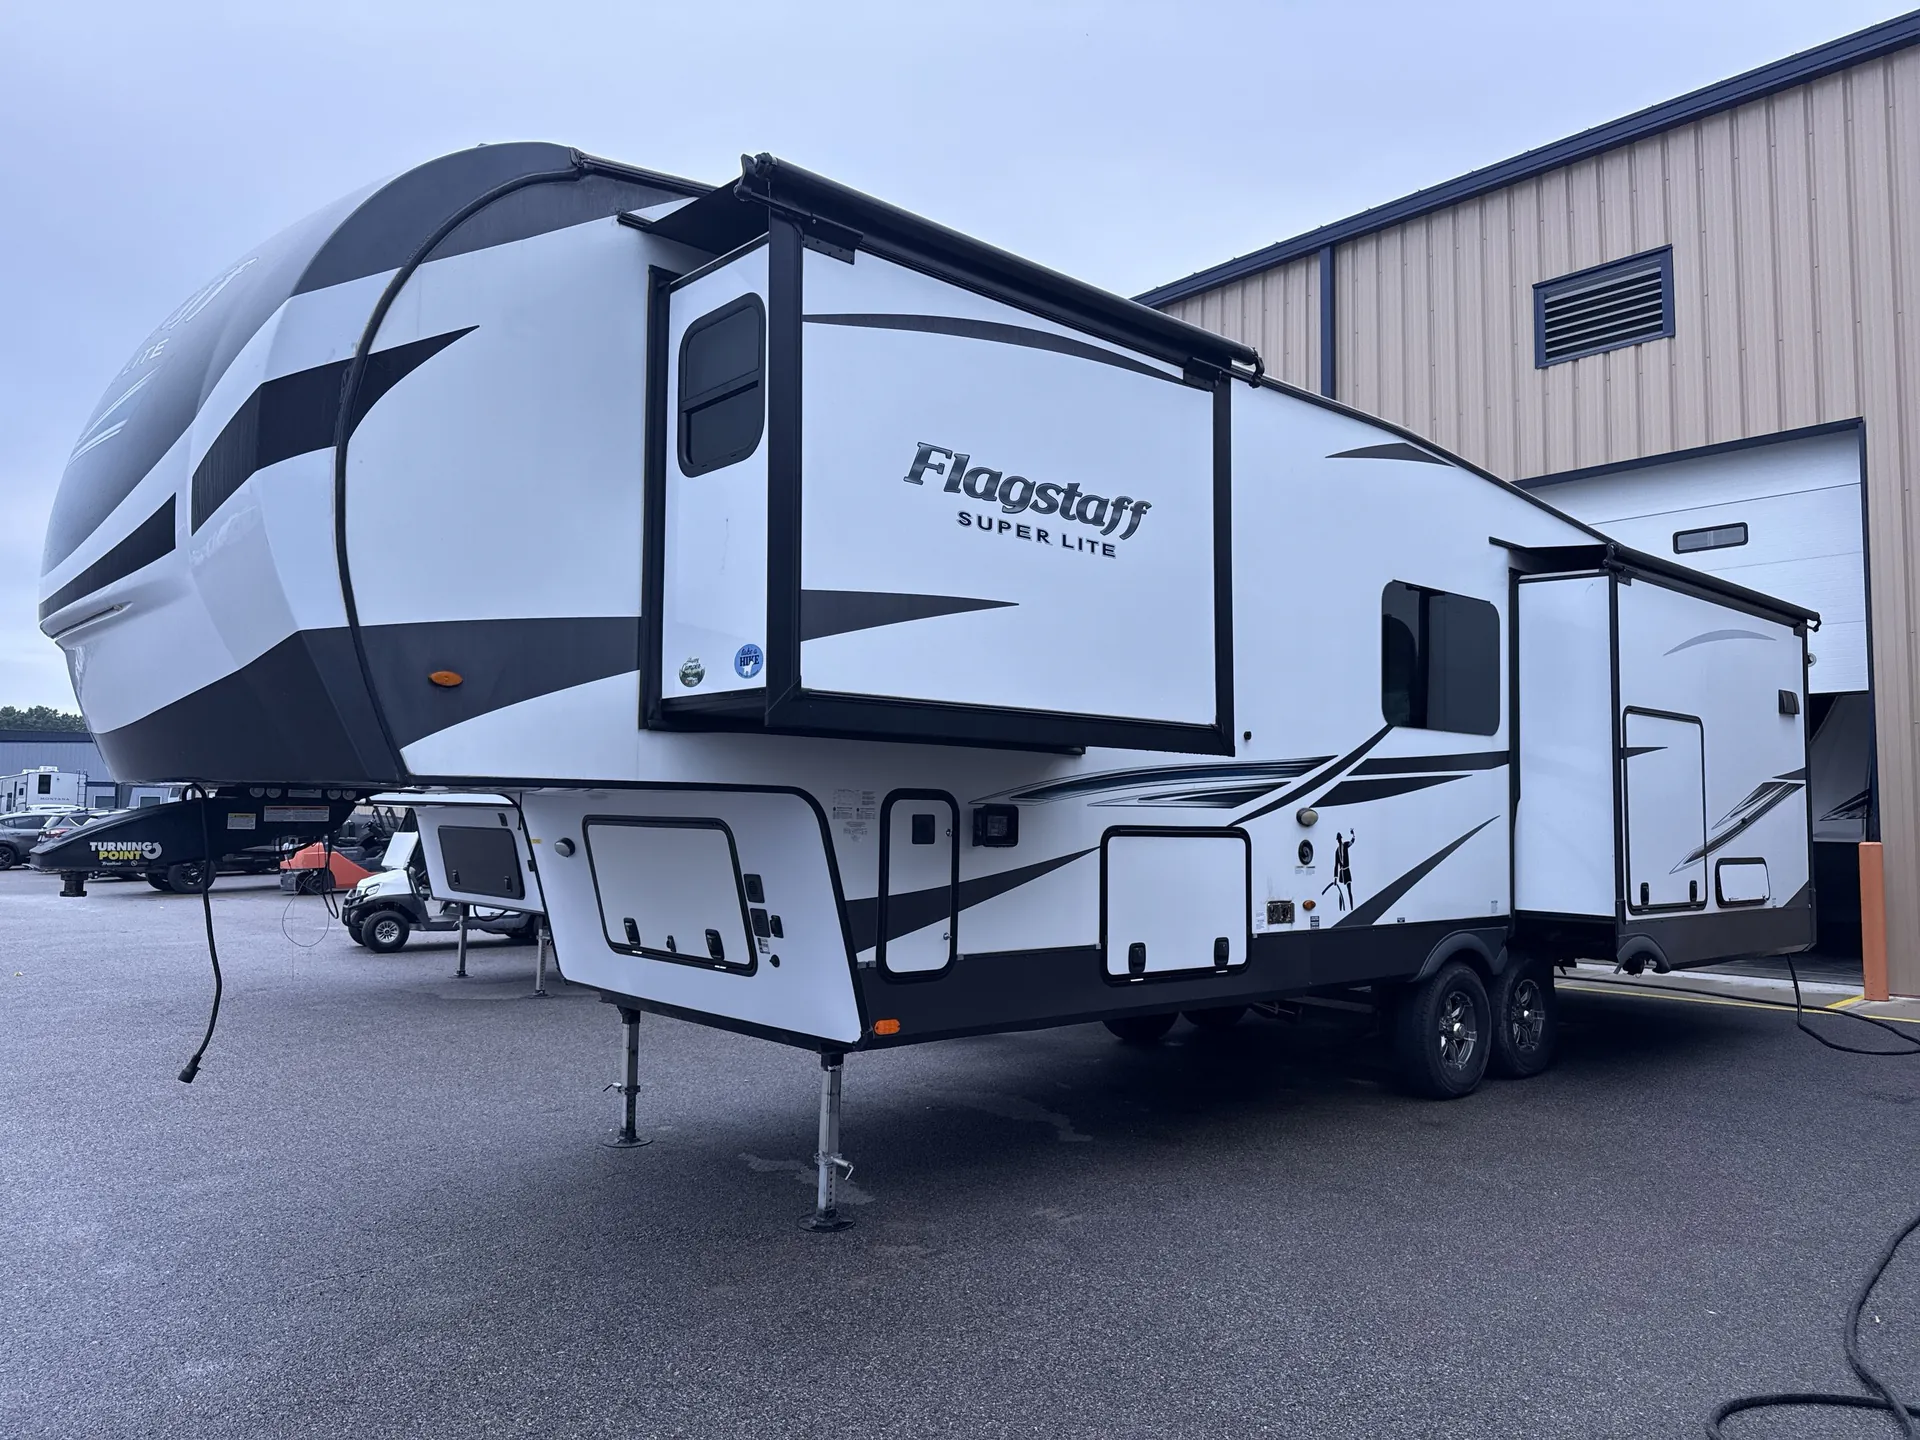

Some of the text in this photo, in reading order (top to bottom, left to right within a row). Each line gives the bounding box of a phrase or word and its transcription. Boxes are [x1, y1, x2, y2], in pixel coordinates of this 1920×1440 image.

[903, 441, 1153, 540] Flagstaff
[956, 510, 1117, 559] SUPER LITE
[740, 655, 759, 666] HIKE
[90, 842, 152, 851] TURNING
[99, 851, 141, 860] POINT
